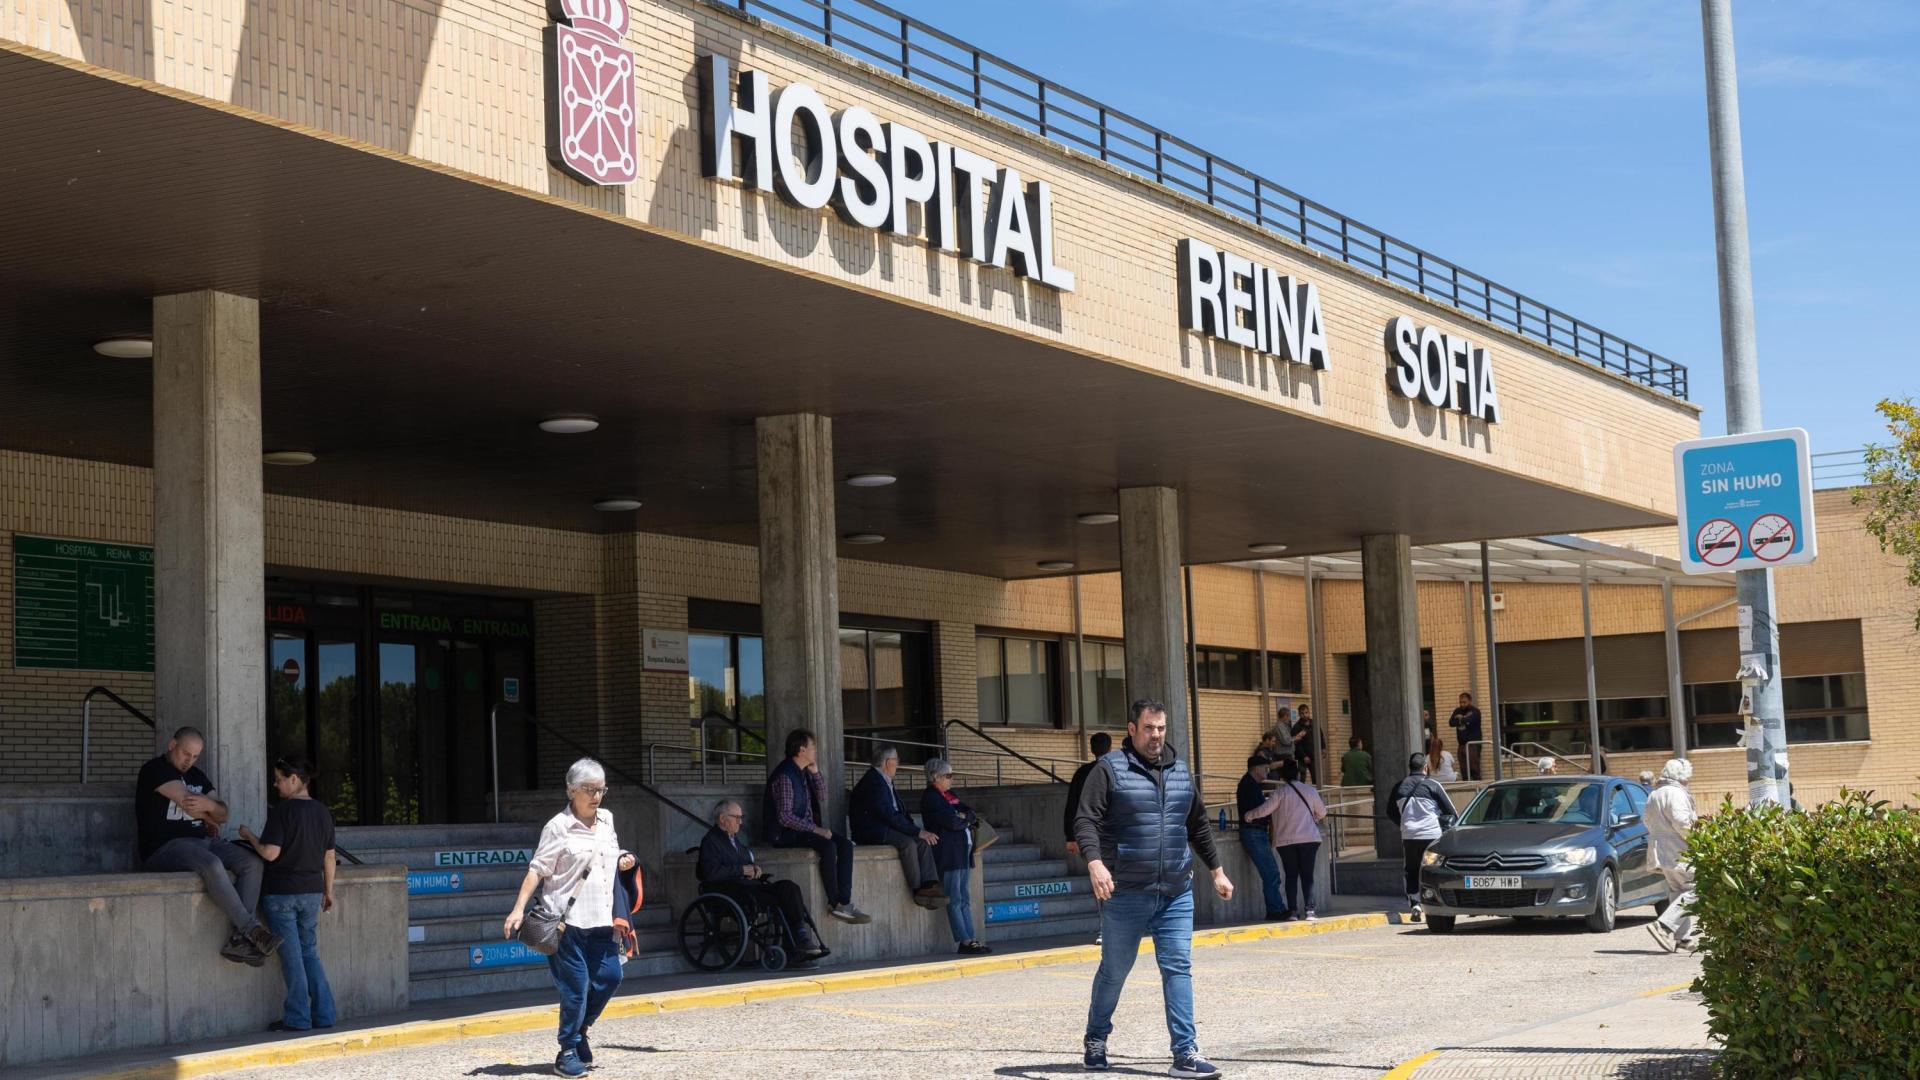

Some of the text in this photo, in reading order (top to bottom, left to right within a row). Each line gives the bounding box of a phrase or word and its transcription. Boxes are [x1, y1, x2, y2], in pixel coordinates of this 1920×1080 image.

[702, 53, 1499, 424] HOSPITAL REINA SOFIA
[1700, 461, 1735, 476] ZONA
[1702, 473, 1782, 494] SIN HUMO
[55, 543, 98, 557] HOSPITAL
[106, 547, 132, 560] REINA
[265, 603, 305, 623] LIDA
[380, 612, 453, 633] ENTRADA
[464, 618, 530, 637] ENTRADA
[440, 850, 528, 865] ENTRADA
[407, 875, 448, 889] SIN HUMO
[1017, 883, 1068, 896] ENTRADA
[1473, 877, 1519, 887] 6067 HWP
[485, 947, 509, 961] ZONA
[510, 946, 525, 959] SIN
